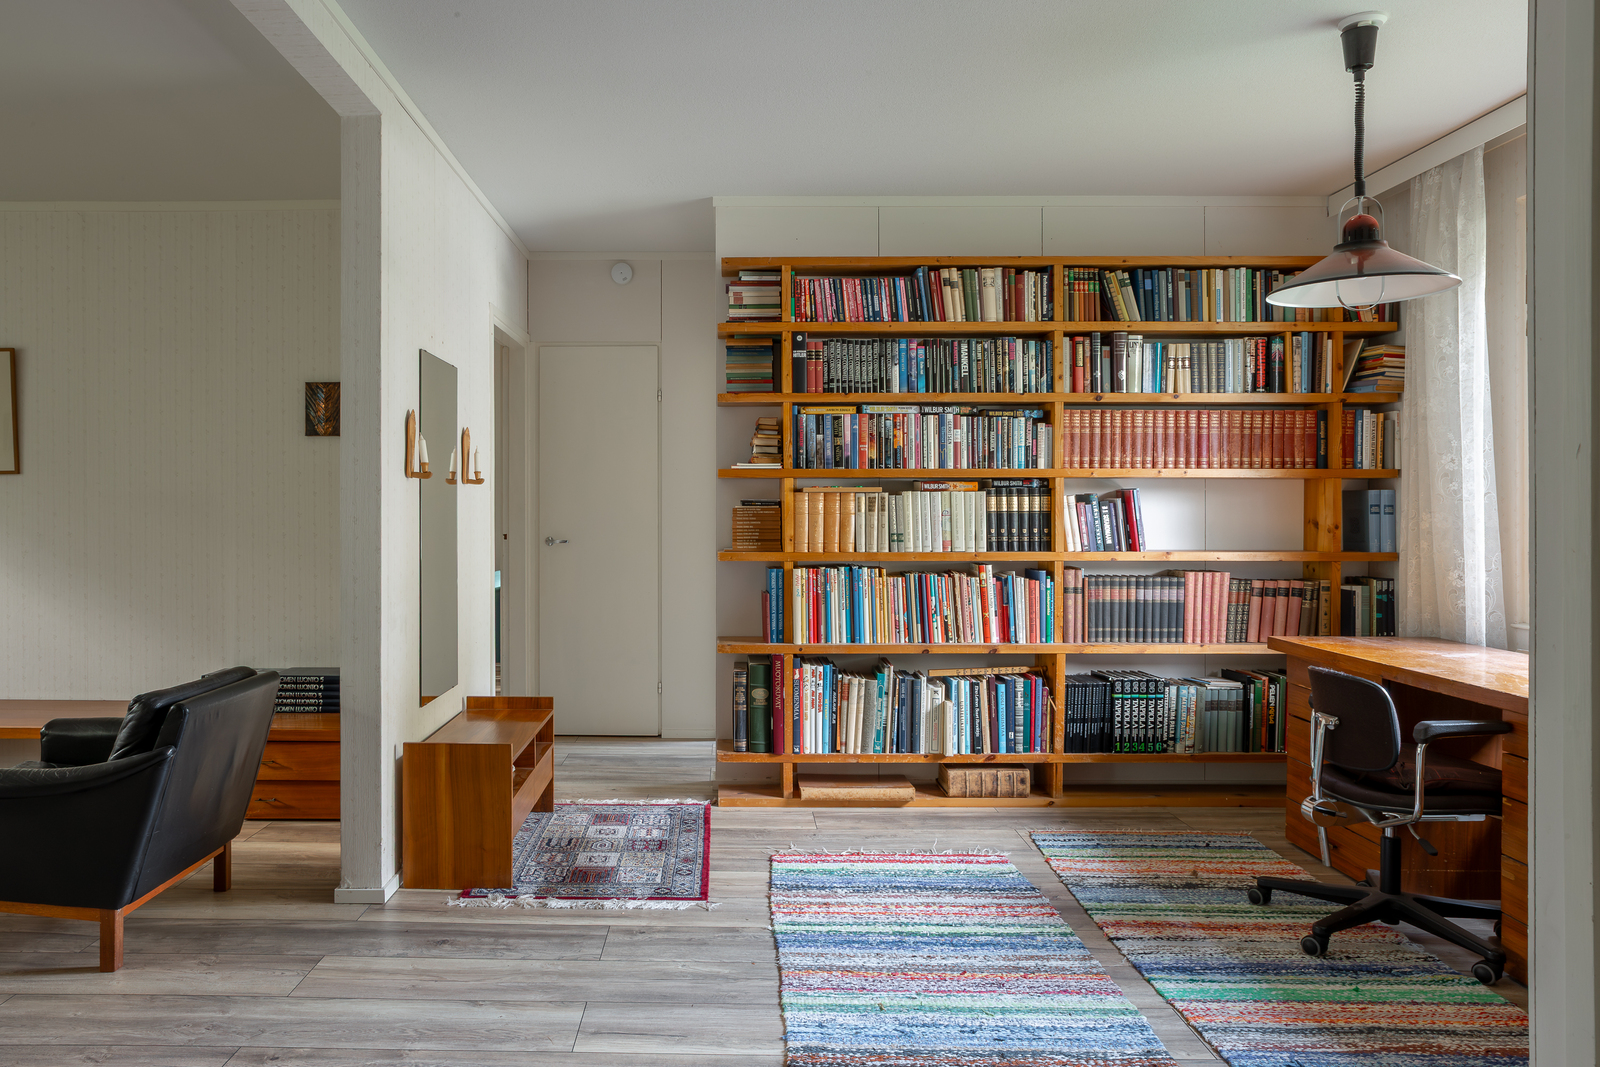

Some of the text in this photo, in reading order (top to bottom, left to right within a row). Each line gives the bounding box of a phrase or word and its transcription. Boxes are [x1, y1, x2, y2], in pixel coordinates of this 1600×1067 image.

[961, 346, 969, 377] MANKELL
[1257, 339, 1266, 374] LUDLUM
[1114, 698, 1122, 729] TAPIOLA
[1123, 698, 1131, 729] TAPIOLA
[1131, 698, 1139, 729] TAPIOLA
[1139, 698, 1147, 729] TAPIOLA
[1156, 698, 1164, 729] TAPIOLA
[1115, 742, 1120, 751] 1
[1123, 742, 1130, 751] 2
[1132, 742, 1138, 751] 3
[1139, 742, 1145, 751] 4
[1147, 742, 1154, 751] 5
[1156, 742, 1162, 751] 6
